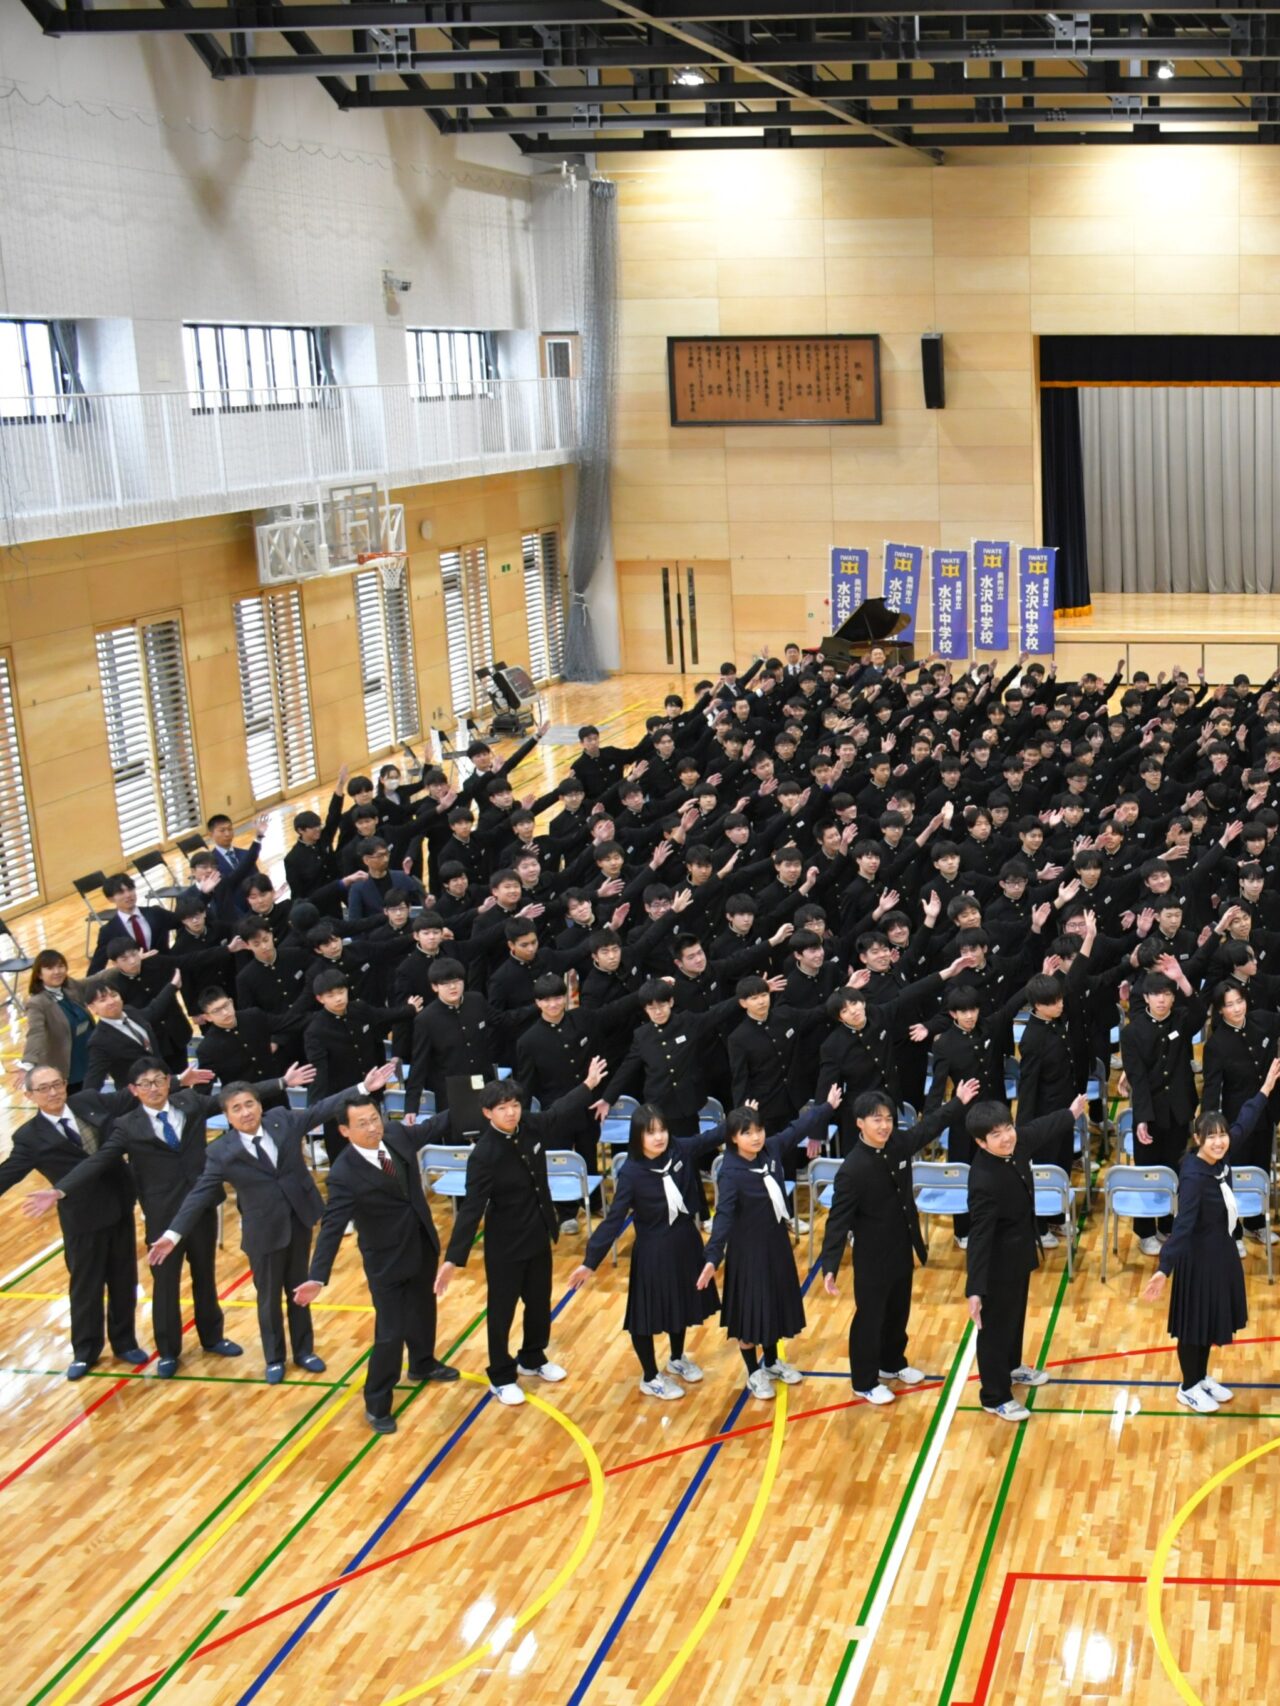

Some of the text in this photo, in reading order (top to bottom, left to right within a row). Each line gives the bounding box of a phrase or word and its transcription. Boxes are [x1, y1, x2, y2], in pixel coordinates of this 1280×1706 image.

[939, 584, 952, 654] 水沢中学校
[980, 575, 994, 644] 水沢中学校
[1026, 582, 1039, 651] 水沢中学校
